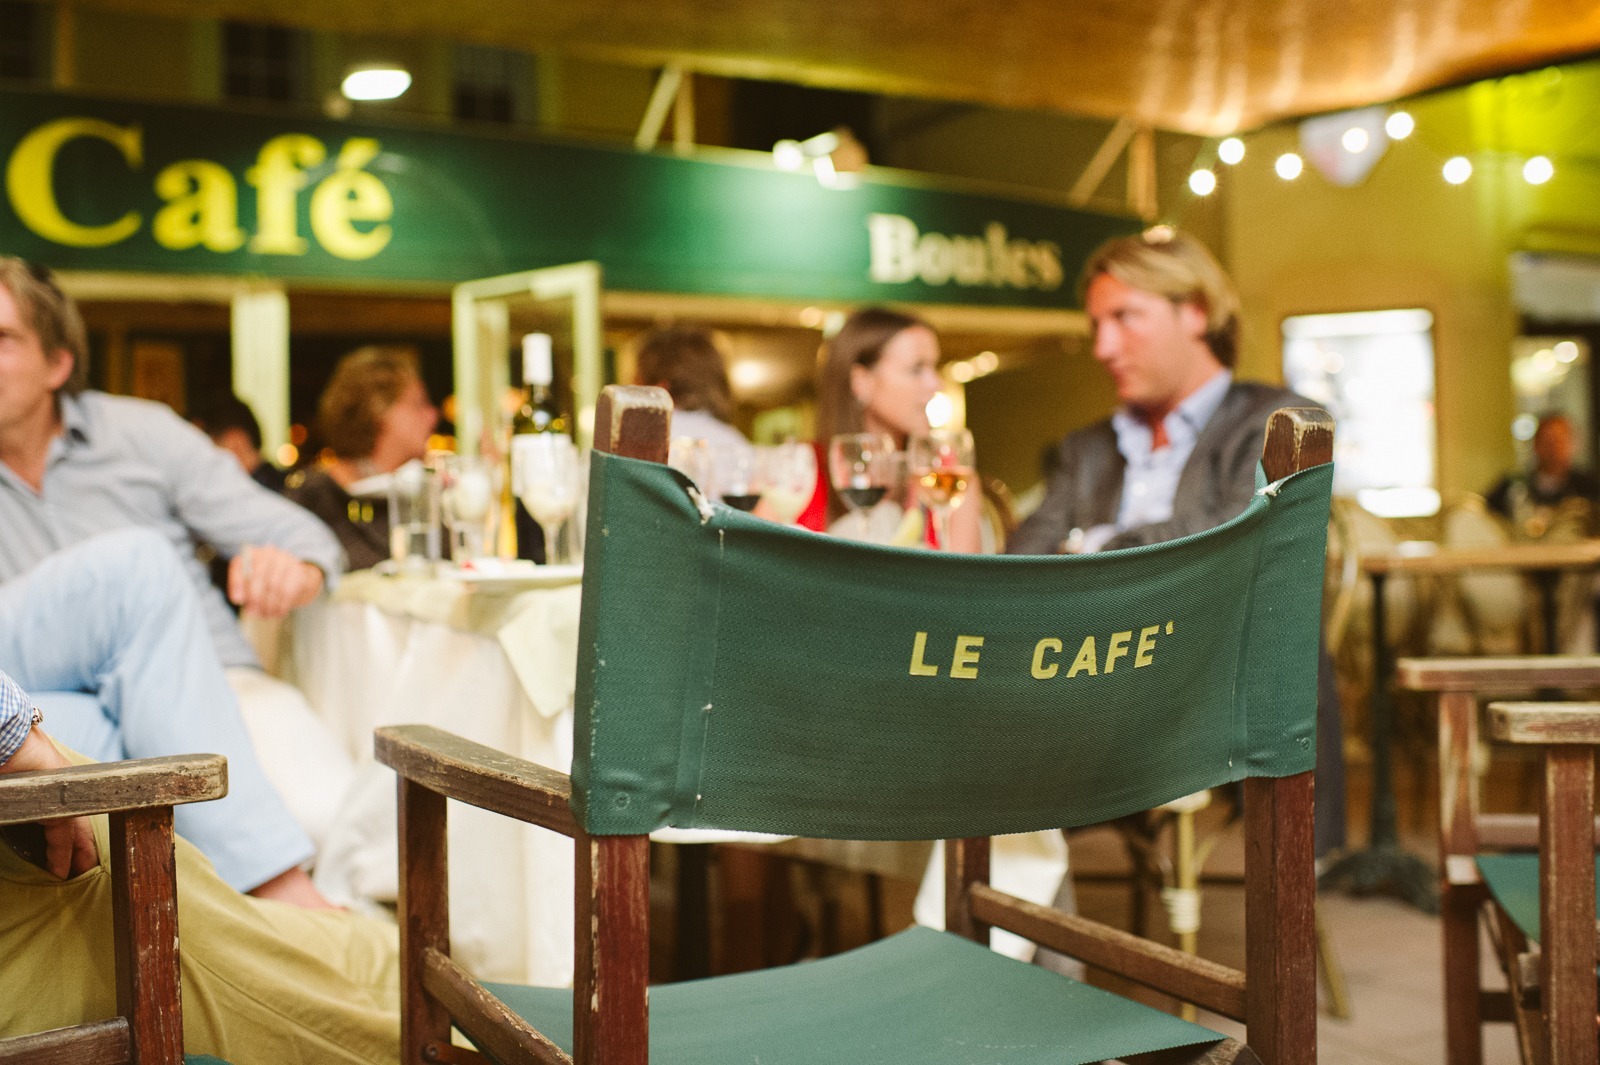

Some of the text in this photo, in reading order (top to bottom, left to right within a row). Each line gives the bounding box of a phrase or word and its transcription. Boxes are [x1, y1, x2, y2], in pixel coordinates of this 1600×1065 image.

[6, 116, 394, 261] Café
[868, 212, 1064, 290] Boules
[909, 631, 984, 679] LE
